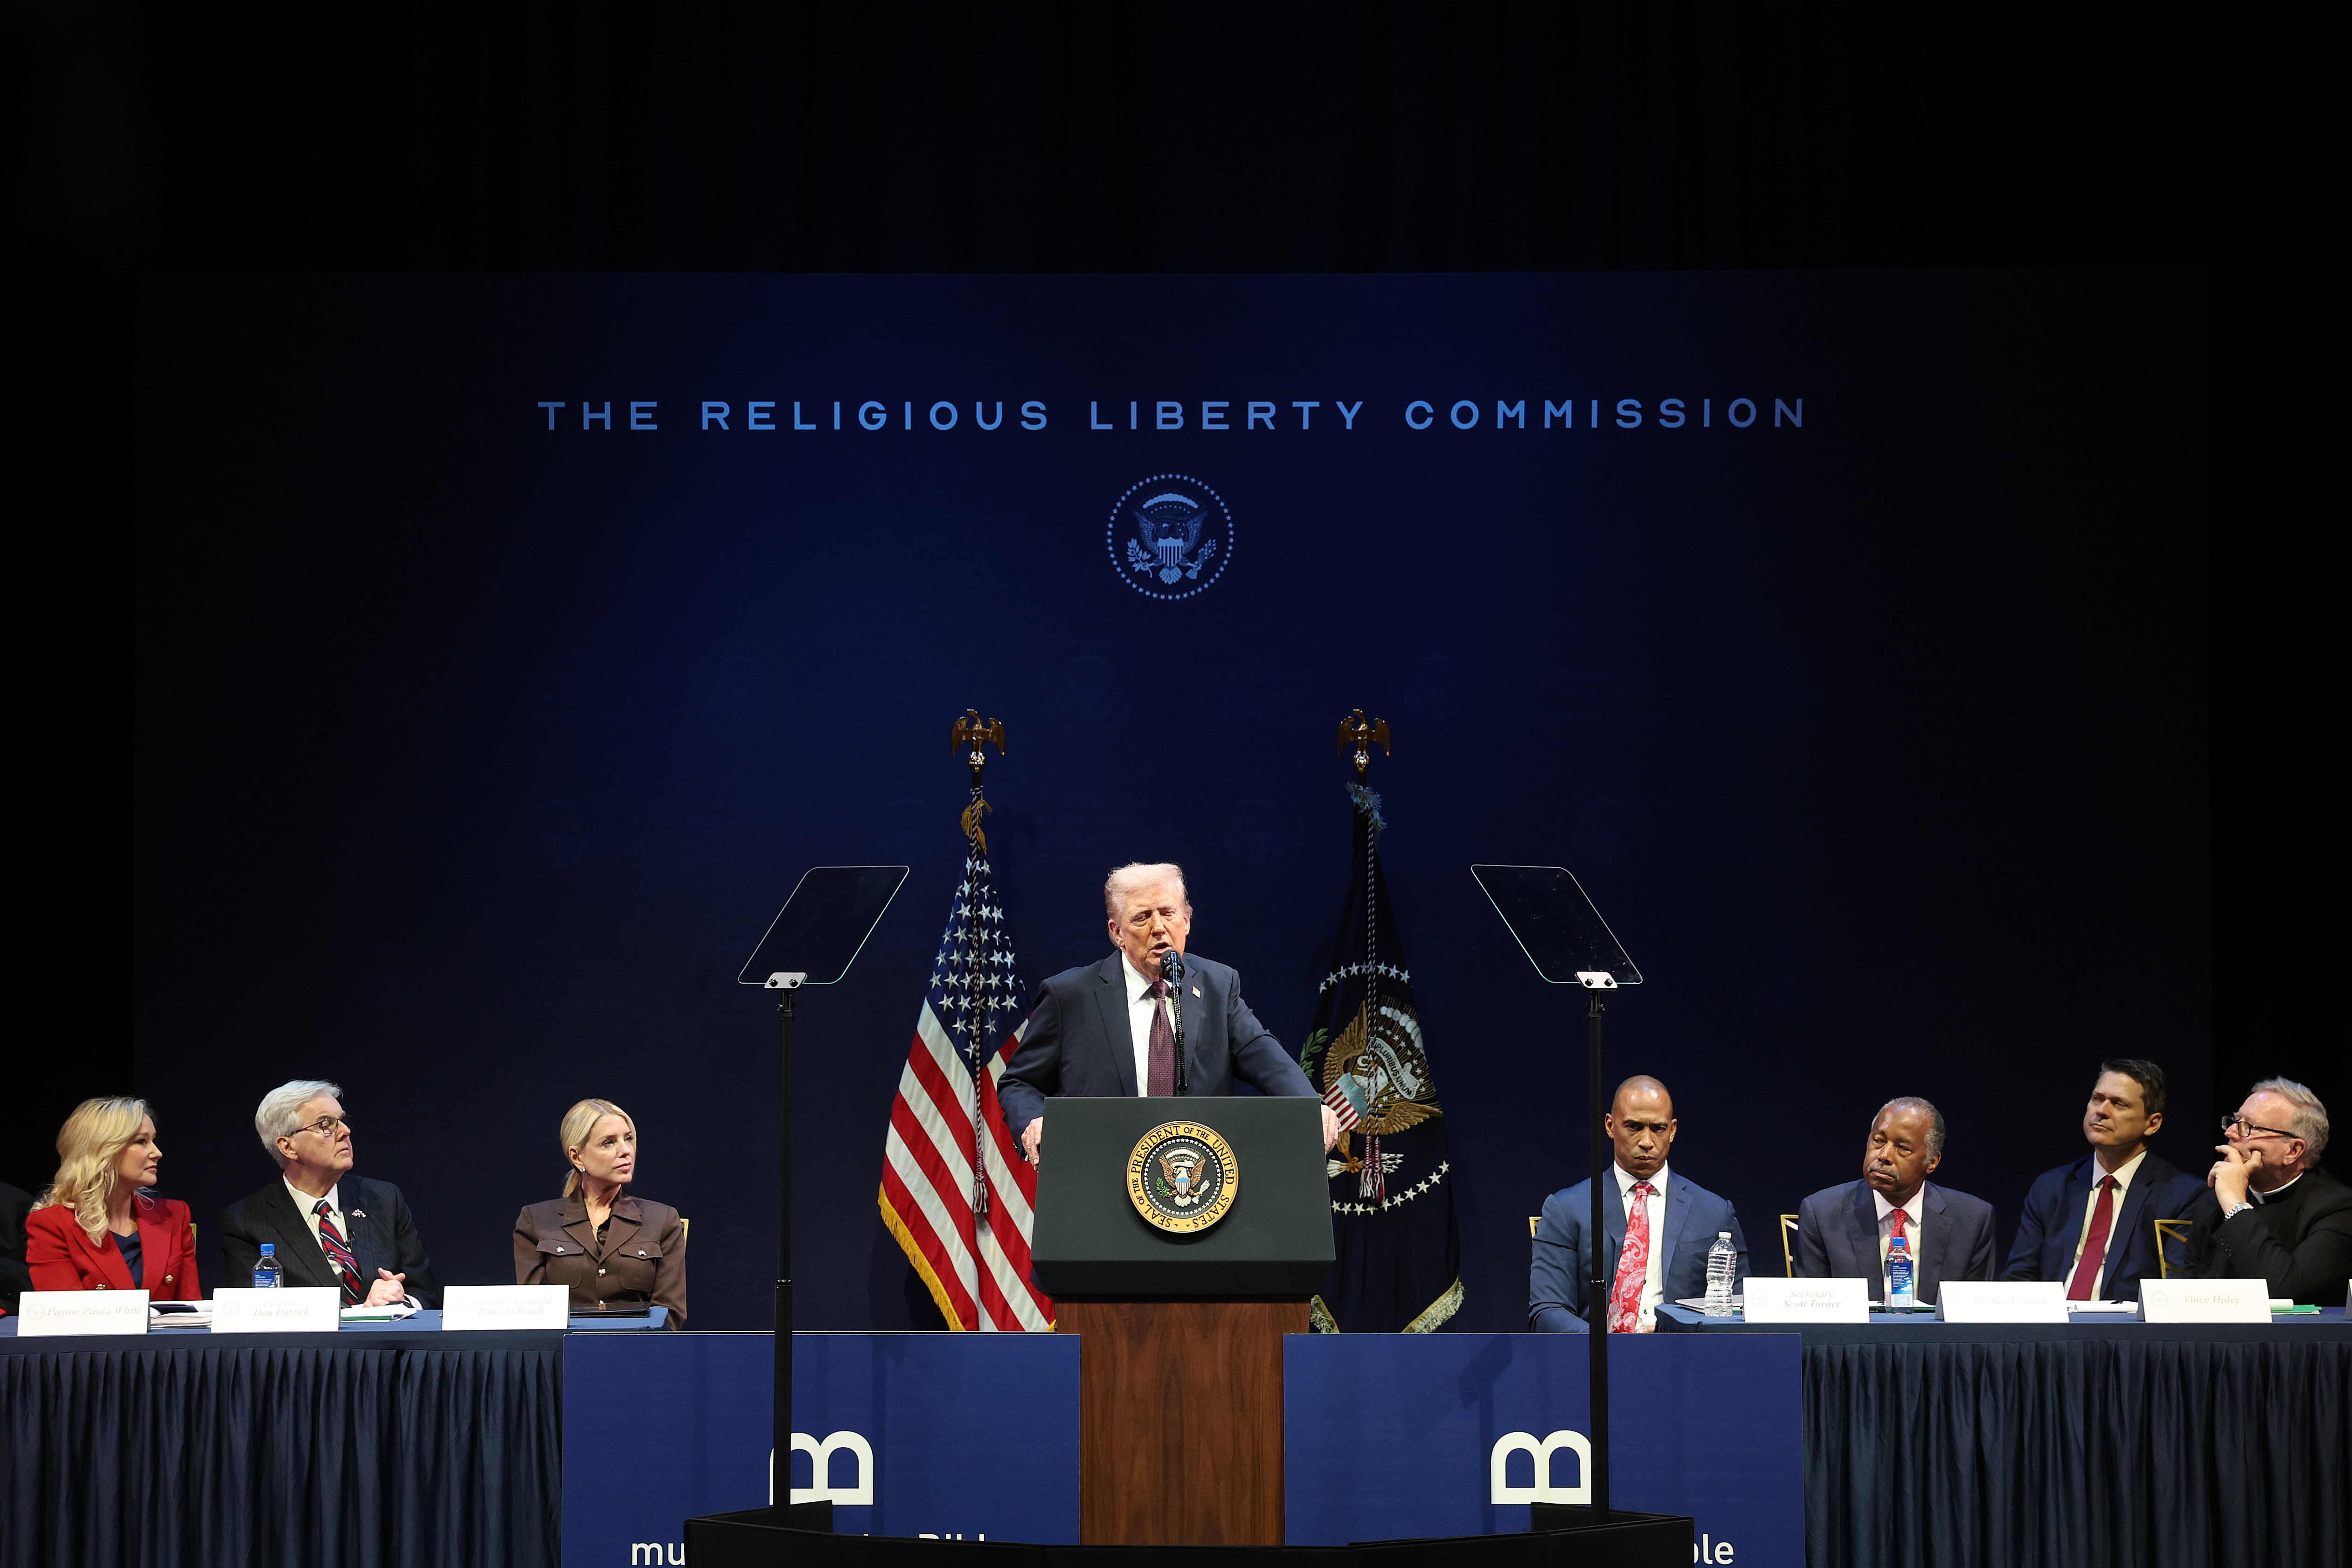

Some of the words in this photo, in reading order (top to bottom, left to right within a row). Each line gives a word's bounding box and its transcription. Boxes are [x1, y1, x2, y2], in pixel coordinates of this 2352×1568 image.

[538, 401, 658, 430] THE
[702, 401, 1047, 430] RELIGIOUS
[1090, 401, 1363, 430] LIBERTY
[1405, 398, 1802, 430] COMMISSION
[1376, 1043, 1400, 1076] PLURIBUS
[1396, 1075, 1413, 1097] UNUM
[1196, 1129, 1210, 1140] THE
[1131, 1125, 1180, 1174] PRESIDENT
[1212, 1140, 1234, 1185] UNITED
[1132, 1178, 1140, 1193] THE
[1136, 1196, 1145, 1205] OF
[1144, 1204, 1172, 1228] SEAL
[1192, 1194, 1229, 1228] STATES
[1790, 1290, 1834, 1300] Secretary
[2184, 1295, 2210, 1304] Vince
[2212, 1295, 2241, 1305] Haley
[514, 1297, 553, 1305] General
[1783, 1299, 1807, 1308] Scott
[1810, 1299, 1842, 1308] Turner
[47, 1307, 80, 1316] Pastor
[115, 1306, 142, 1315] White
[276, 1308, 309, 1316] Patrick
[478, 1306, 513, 1315] Pamela
[517, 1306, 545, 1315] Bondi
